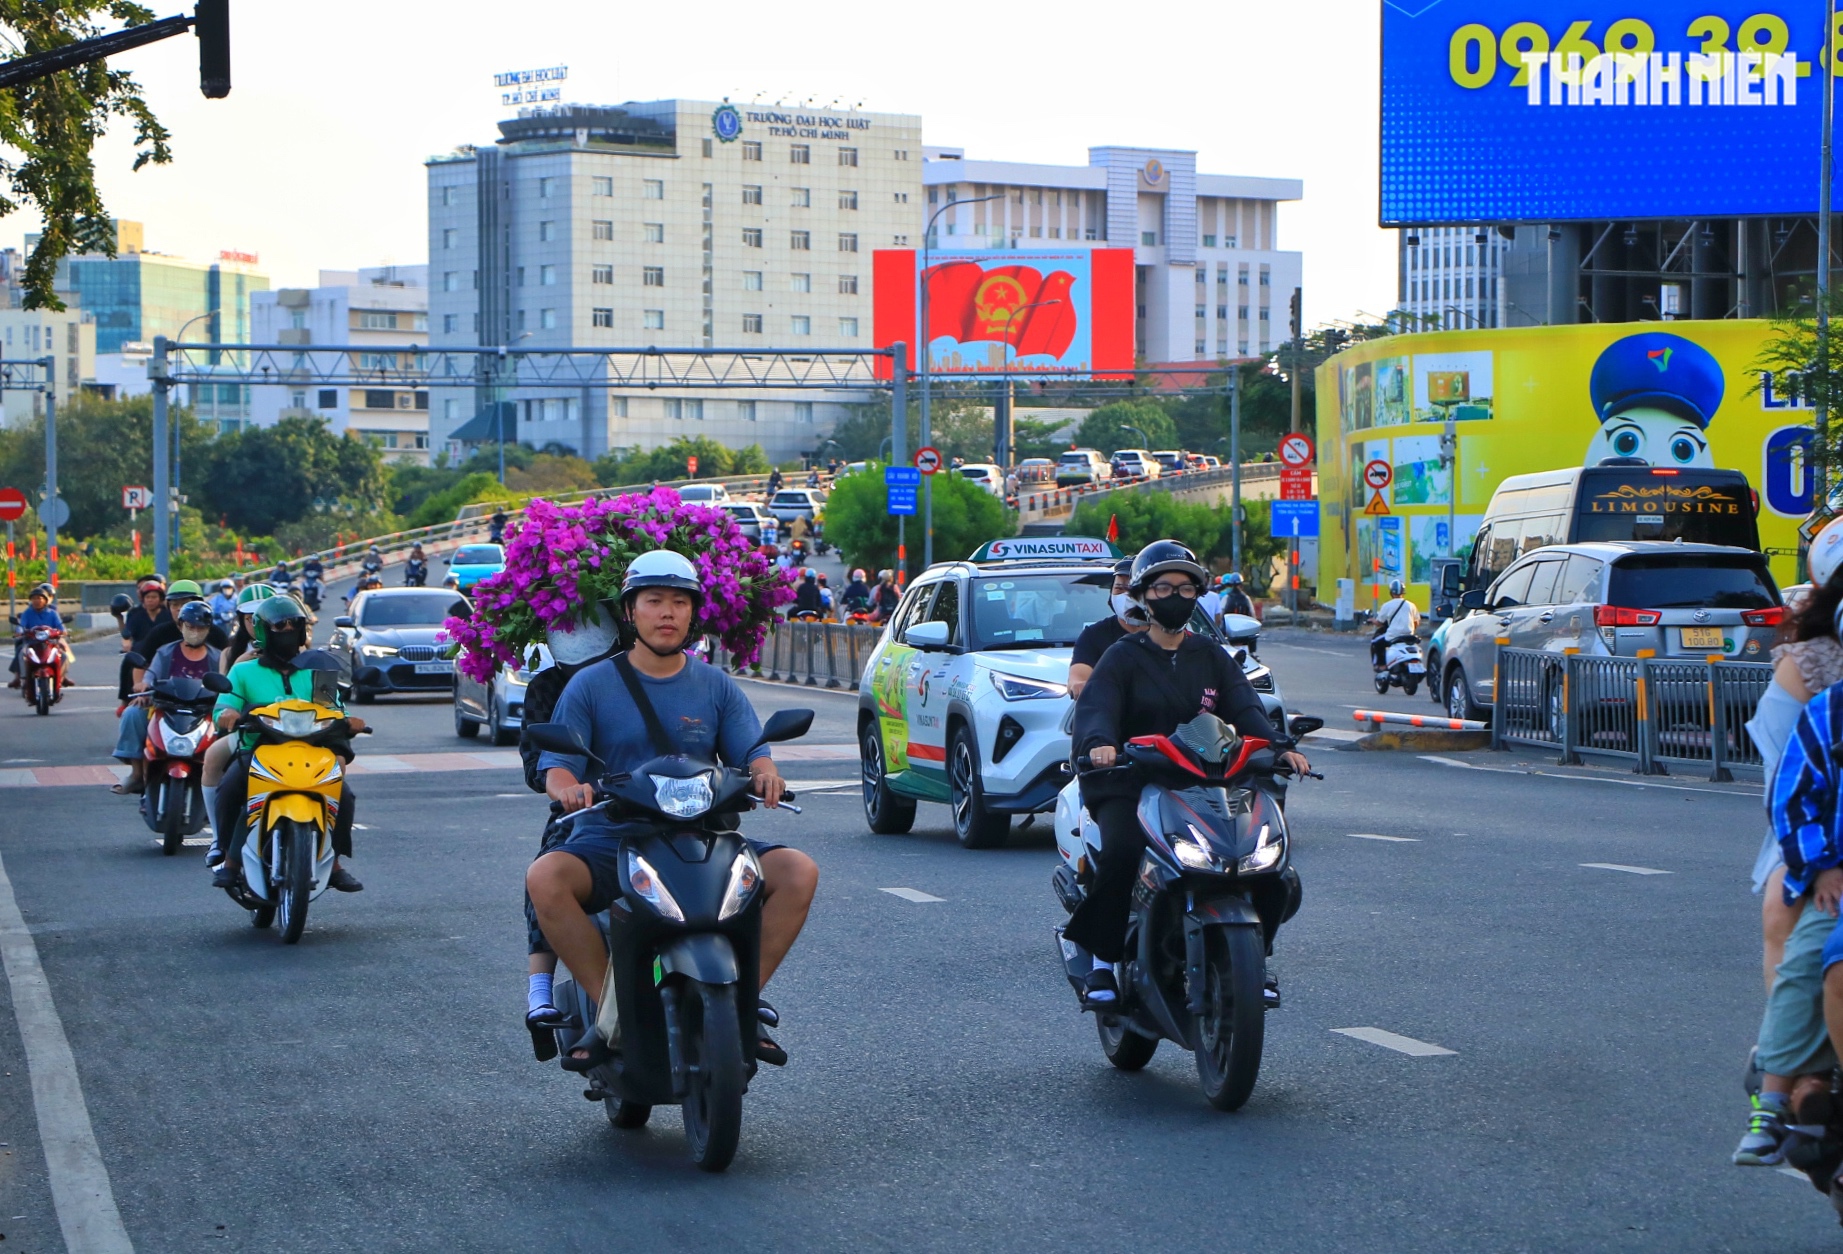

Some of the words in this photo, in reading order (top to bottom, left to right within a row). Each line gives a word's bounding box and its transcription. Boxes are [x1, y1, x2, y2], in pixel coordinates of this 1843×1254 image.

[746, 111, 792, 125] TRƯỜNG
[819, 117, 843, 129] HỌC
[846, 118, 871, 131] LUẬT
[799, 128, 818, 139] CHÍ
[821, 131, 850, 141] MINH
[1592, 502, 1739, 514] LIMOUSINE
[1692, 628, 1711, 637] 51G
[1688, 638, 1720, 646] 100.80
